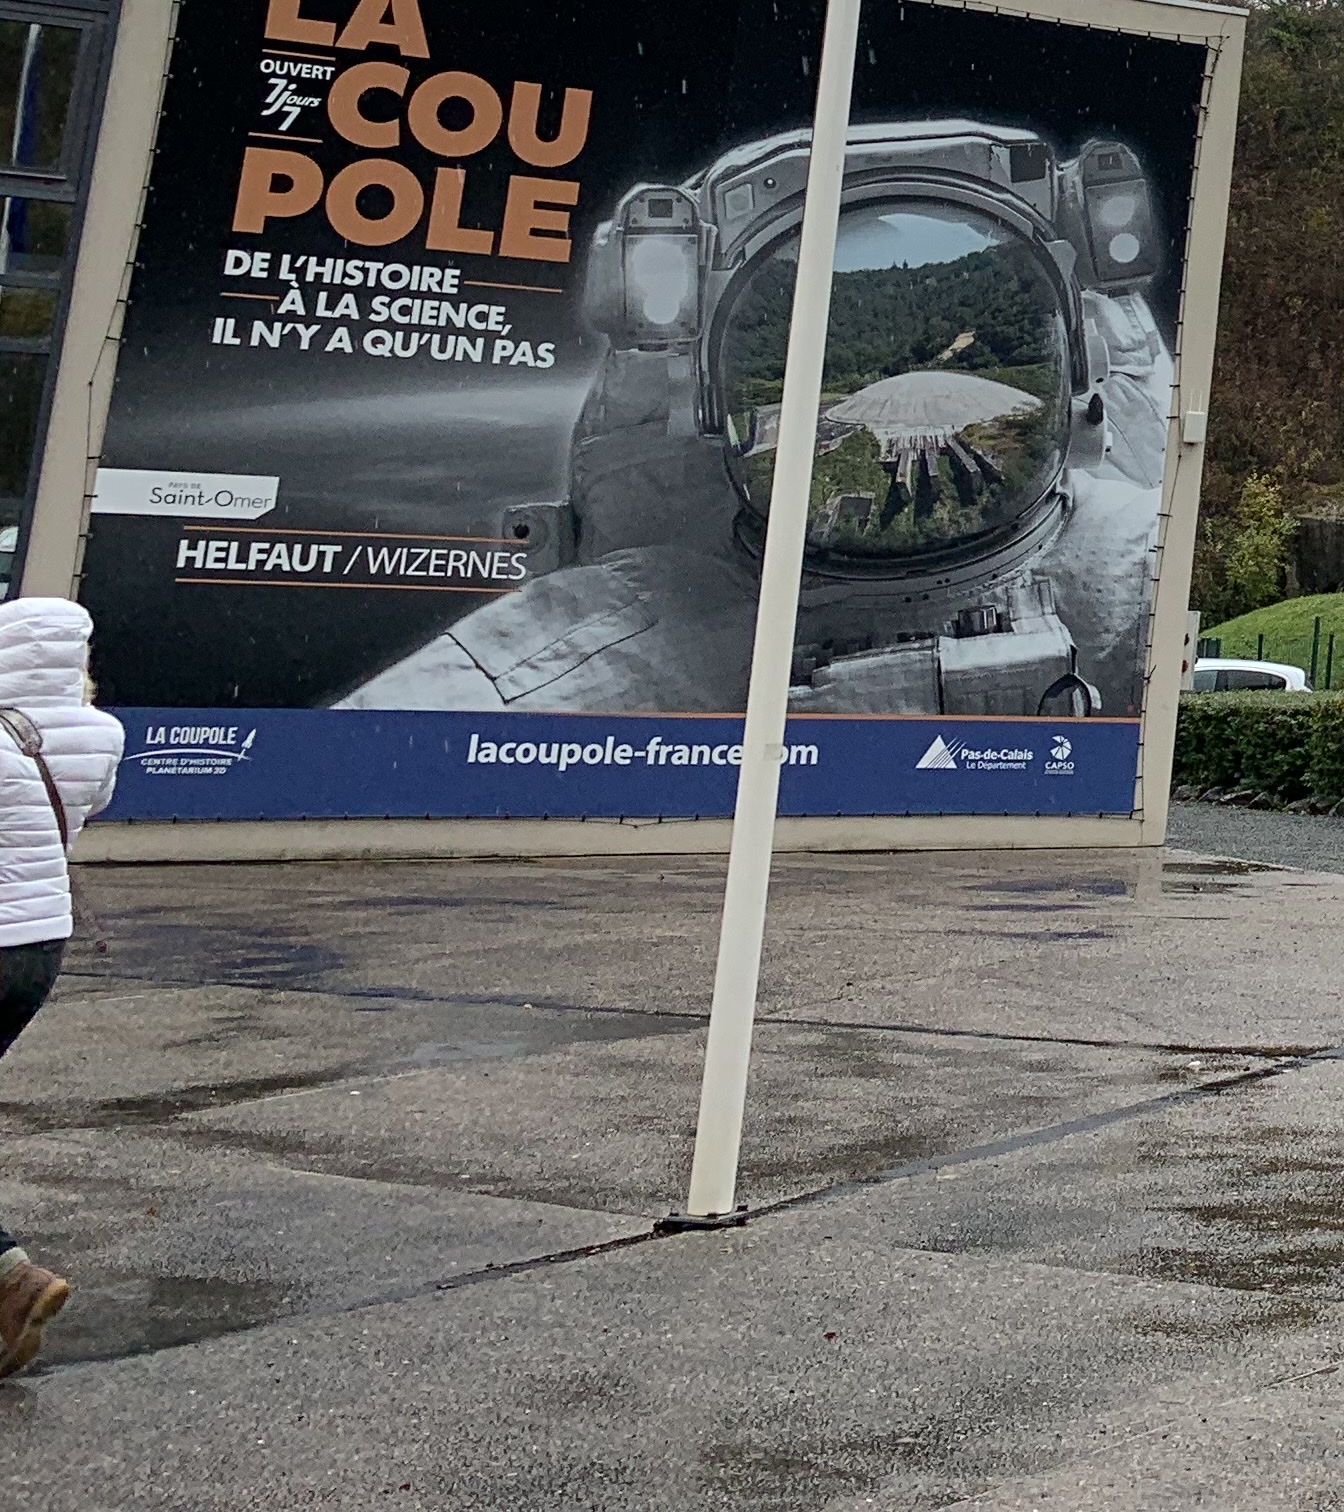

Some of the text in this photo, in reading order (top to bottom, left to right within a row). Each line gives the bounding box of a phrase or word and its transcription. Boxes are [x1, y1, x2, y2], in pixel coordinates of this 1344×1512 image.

[260, 59, 336, 81] OUVERT
[327, 61, 593, 168] COU
[232, 147, 580, 263] POLE
[224, 249, 461, 294] DE L'HISTOIRE
[277, 280, 513, 336] À LA SCIENCE,
[211, 317, 556, 369] IL N'Y A QU'UN PAS
[176, 539, 342, 574] HELFAUT
[365, 546, 528, 580] WIZERNES
[146, 726, 239, 745] LA COUPOLE
[961, 748, 1034, 760] Pas-de-Calais
[966, 761, 976, 769] Le
[1045, 761, 1075, 770] CAPSO
